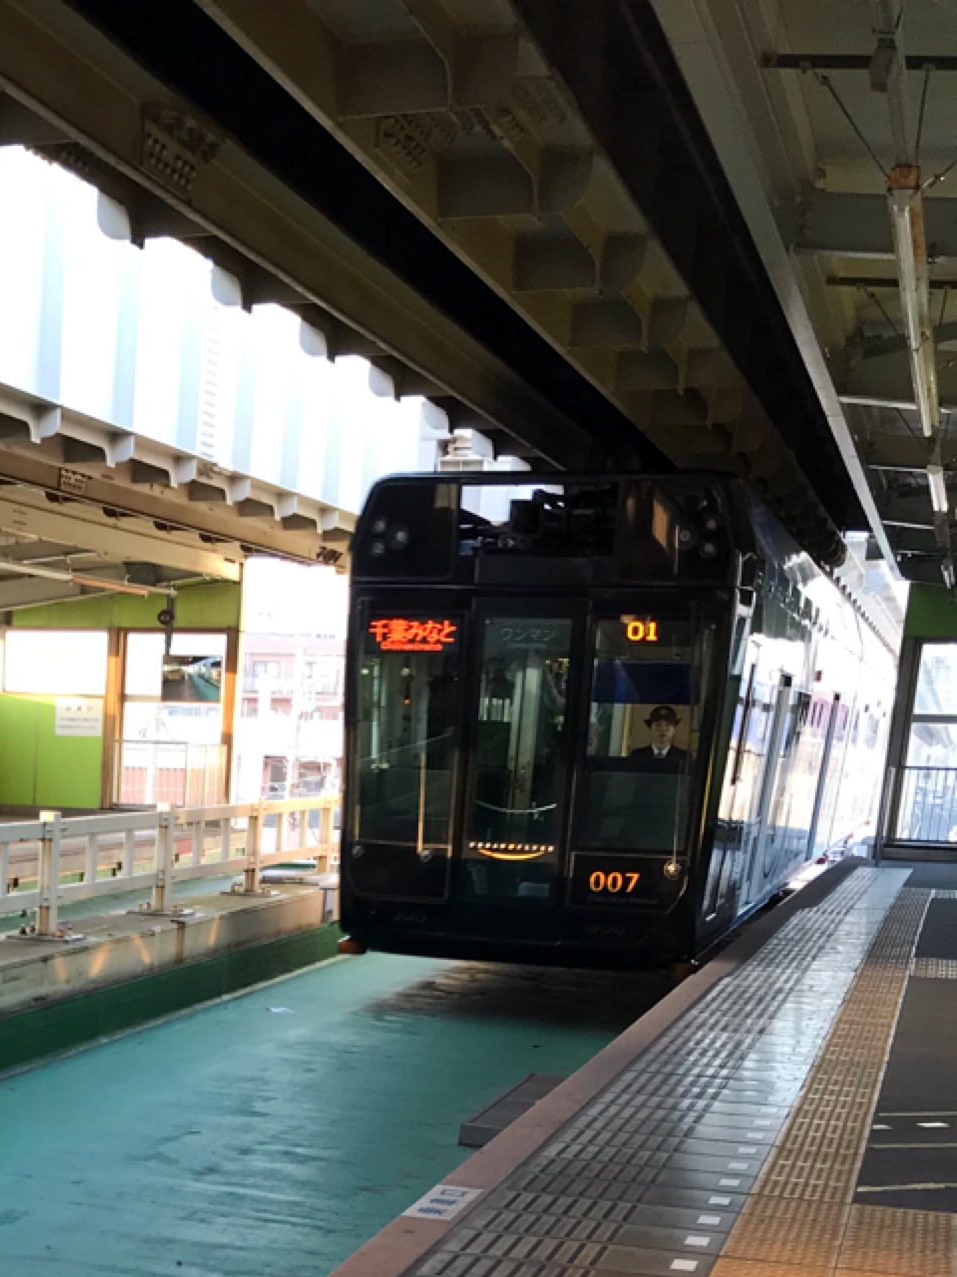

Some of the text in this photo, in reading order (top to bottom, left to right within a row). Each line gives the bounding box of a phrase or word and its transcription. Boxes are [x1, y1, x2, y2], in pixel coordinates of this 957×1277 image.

[368, 619, 457, 642] 千葉みなと
[500, 628, 556, 641] ワンマン
[627, 621, 658, 642] 01
[589, 872, 640, 893] 007
